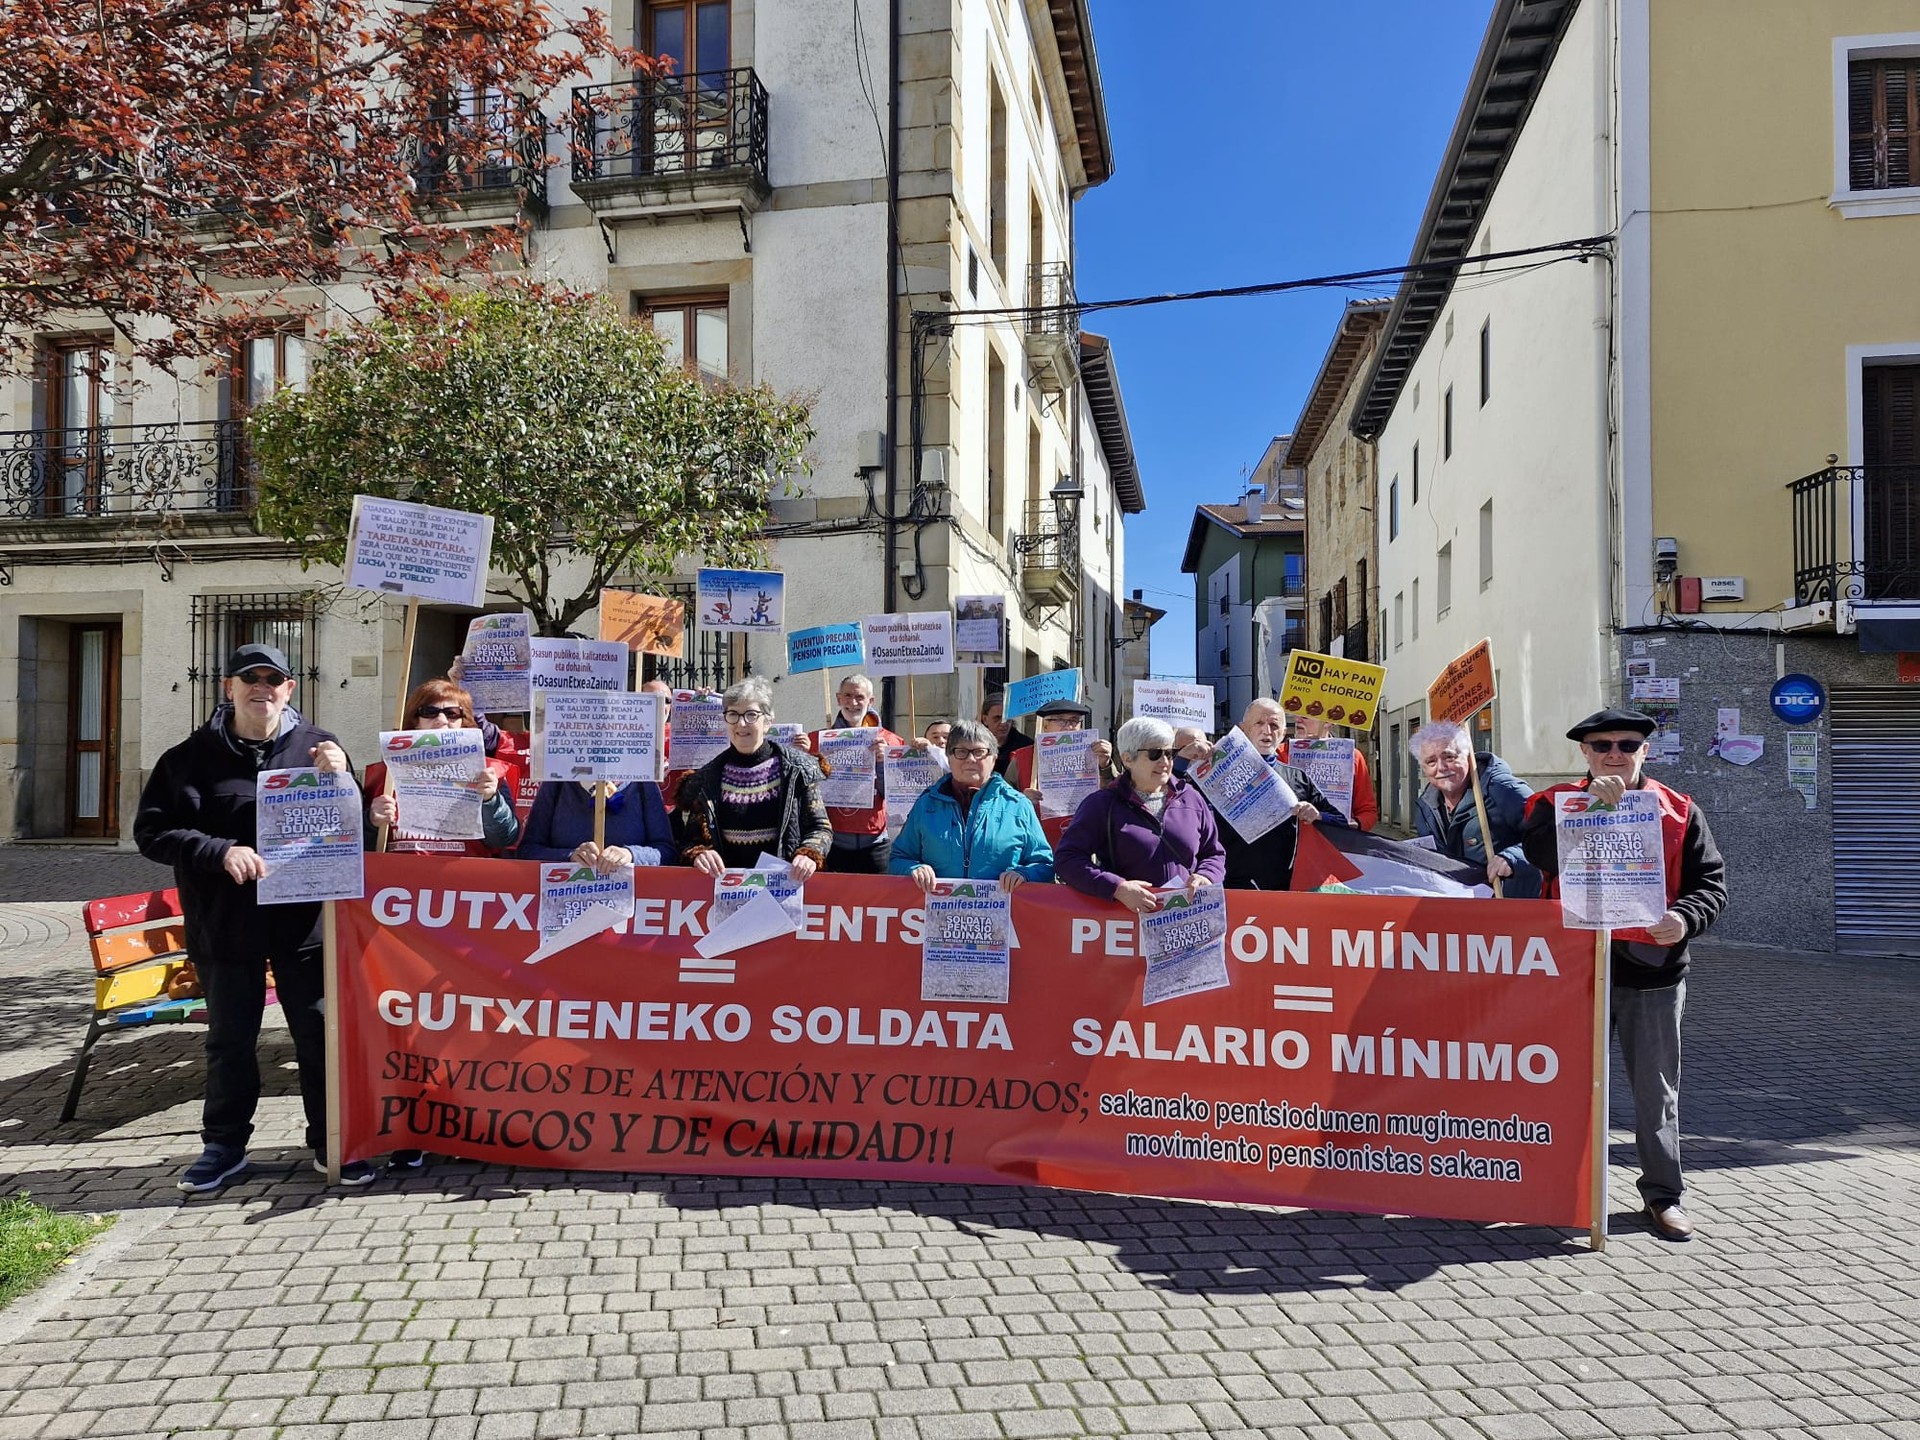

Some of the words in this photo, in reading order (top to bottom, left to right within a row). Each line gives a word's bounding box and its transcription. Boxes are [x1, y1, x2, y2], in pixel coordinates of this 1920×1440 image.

[363, 504, 396, 515] CUANDO
[399, 510, 426, 519] VISITES
[428, 514, 441, 522] LOS
[444, 517, 478, 528] CENTROS
[384, 515, 408, 525] SALUD
[431, 522, 455, 532] PIDAN
[458, 527, 468, 536] LA
[367, 531, 410, 546] TARJETA
[411, 537, 466, 554] SANITARIA
[409, 528, 435, 538] LUGAR
[438, 532, 448, 540] DE
[450, 534, 460, 542] LA
[358, 548, 370, 556] DE
[372, 550, 383, 558] LO
[386, 552, 402, 562] QUE
[405, 555, 417, 563] NO
[383, 542, 418, 554] CUANDO
[421, 548, 431, 557] TE
[434, 550, 476, 564] ACUERDES
[358, 556, 386, 568] LUCHA
[390, 561, 396, 569] Y
[399, 563, 440, 576] DEFIENDE
[443, 569, 468, 580] TODO
[386, 570, 397, 579] LO
[470, 630, 524, 640] manifestazioa
[868, 624, 888, 633] Osasun
[912, 622, 942, 632] kalitatezkoa
[792, 635, 824, 650] JUVENTUD
[826, 631, 858, 644] PRECARIA
[582, 650, 618, 662] kalitatezkoa
[793, 648, 822, 662] PENSION
[823, 644, 856, 656] PRECARIA
[872, 644, 944, 658] #OsasunEtxeaZaindu
[1460, 646, 1486, 668] QUIEN
[555, 664, 566, 672] eta
[1297, 660, 1320, 674] NO
[1324, 668, 1349, 680] HAY
[1352, 674, 1376, 686] PAN
[532, 674, 619, 690] #OsasunEtxeaZaindu
[1024, 674, 1062, 688] SOLDATA
[1029, 683, 1055, 693] DUINA
[1289, 684, 1311, 694] TANTO
[1292, 676, 1313, 686] PARA
[1440, 664, 1474, 698] GOBIERNE
[1018, 688, 1064, 704] PENTSIOAK
[1320, 682, 1374, 702] CHORIZO
[1448, 682, 1464, 700] LAS
[1440, 682, 1482, 720] PENSIONES
[1775, 696, 1819, 705] DIGI
[1140, 704, 1206, 718] #OsasunEtxeaZaindu
[554, 722, 594, 730] TARJETA
[596, 722, 644, 731] SANITARIA
[570, 730, 602, 738] CUANDO
[616, 731, 654, 739] ACUERDES
[387, 733, 442, 750] 5A
[391, 744, 478, 764] manifestazioa
[1293, 752, 1350, 760] manifestazioa
[1204, 742, 1248, 788] manifestazioa
[264, 772, 320, 789] 5A
[1225, 770, 1257, 798] DUINAK
[264, 786, 354, 804] manifestazioa
[284, 806, 340, 817] SOLDATA
[282, 822, 342, 834] DUINAK
[284, 815, 340, 826] PENTSIO
[1564, 812, 1655, 828] manifestazioa
[1584, 832, 1642, 842] SOLDATA
[1586, 841, 1642, 850] PENTSIO
[1582, 850, 1645, 859] DUINAK
[546, 868, 596, 882] 5A
[720, 873, 767, 886] 5A
[548, 881, 628, 898] manifestazioa
[930, 883, 976, 897] 5A
[931, 900, 1005, 910] manifestazioa
[946, 916, 992, 925] SOLDATA
[1146, 902, 1220, 928] manifestazioa
[944, 931, 993, 940] DUINAK
[947, 924, 992, 933] PENTSIO
[1164, 920, 1208, 938] SOLDATA
[1166, 926, 1209, 944] PENTSIO
[1071, 916, 1310, 965] PEÓN
[1331, 921, 1560, 978] MÍNIMA
[1164, 933, 1212, 952] DUINAK
[378, 988, 752, 1044] GUTXIENEKO
[770, 1004, 1014, 1052] SOLDATA
[1072, 1018, 1310, 1070] SALARIO
[1331, 1027, 1560, 1084] MÍNIMO
[382, 1050, 573, 1094] SERVICIOS
[580, 1066, 634, 1098] DE
[640, 1063, 842, 1104] ATENCIÓN
[850, 1072, 876, 1104] Y
[882, 1074, 1091, 1124] CUIDADOS;
[1100, 1088, 1210, 1122] sakanako
[1215, 1099, 1380, 1134] pentsiodunen
[1386, 1110, 1552, 1145] mugimendua
[377, 1089, 596, 1153] PÚBLICOS
[609, 1112, 643, 1153] Y
[648, 1114, 712, 1157] DE
[723, 1118, 954, 1165] CALIDAD!!
[1126, 1130, 1262, 1165] movimiento
[1267, 1142, 1423, 1175] pensionistas
[1429, 1150, 1522, 1182] sakana
